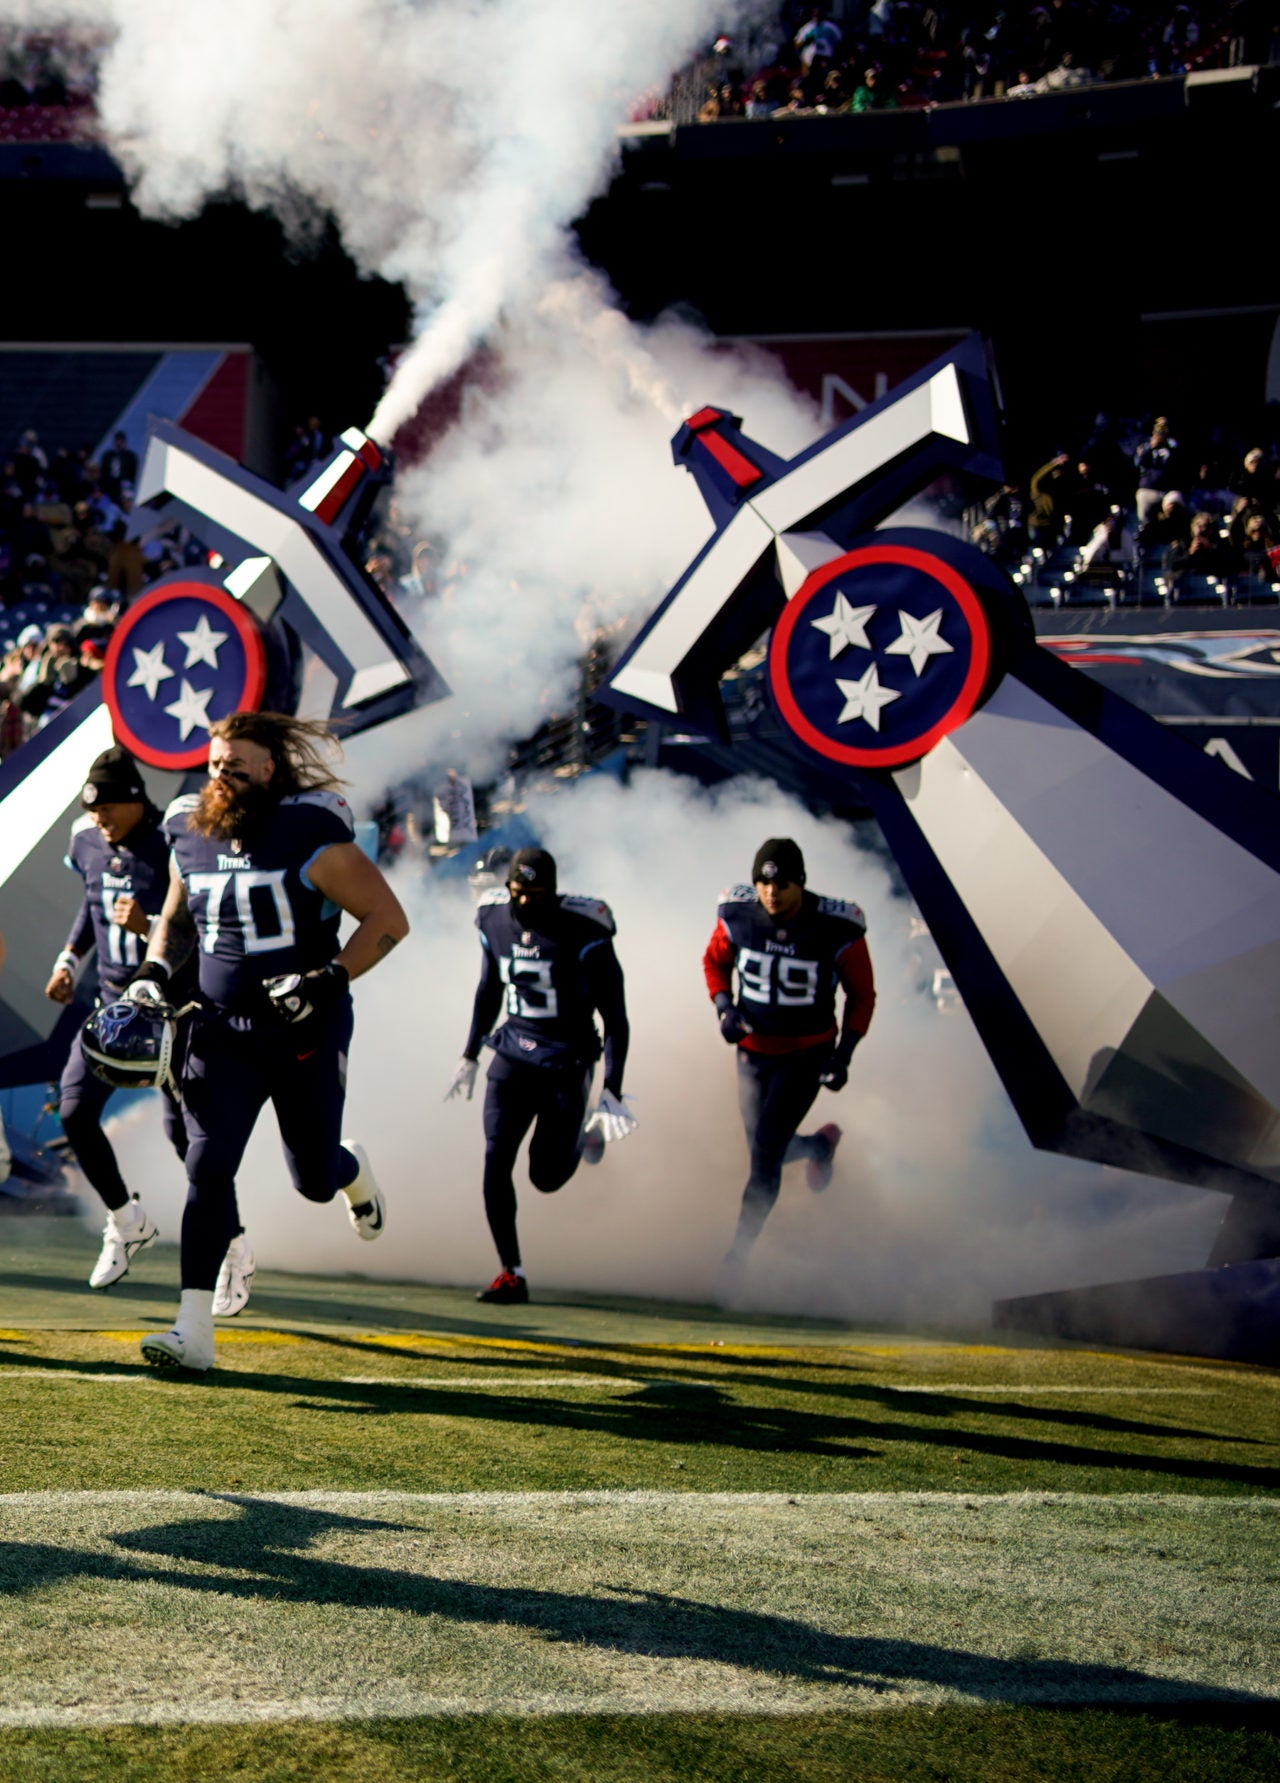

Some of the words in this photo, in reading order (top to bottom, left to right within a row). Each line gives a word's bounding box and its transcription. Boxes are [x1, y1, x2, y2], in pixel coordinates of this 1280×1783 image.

[217, 853, 252, 870] TITANS
[188, 869, 296, 954] 70
[498, 955, 559, 1018] 13
[738, 947, 819, 1006] 99
